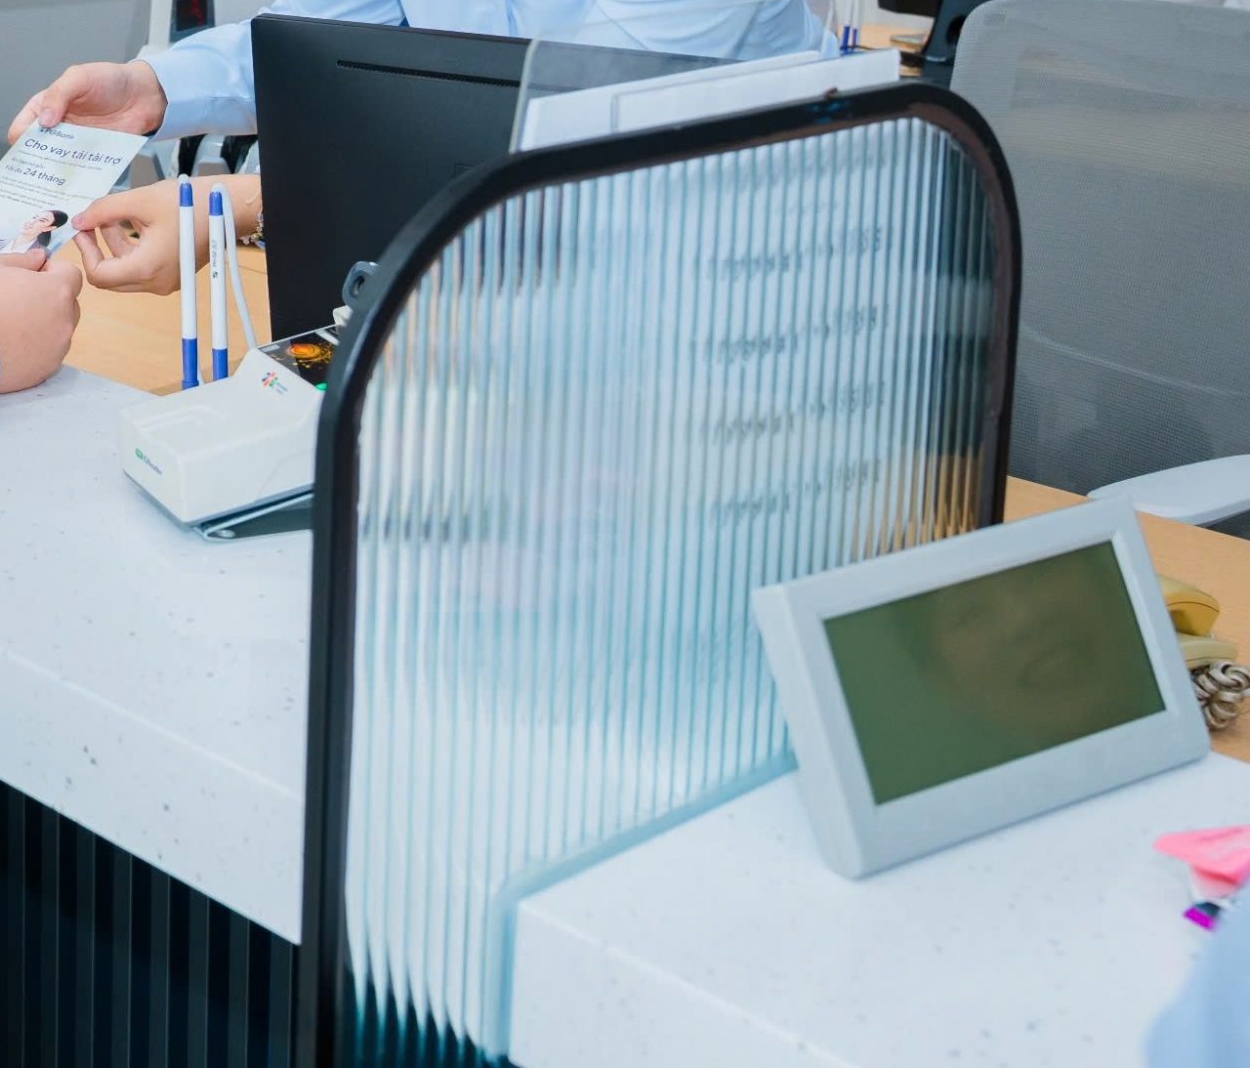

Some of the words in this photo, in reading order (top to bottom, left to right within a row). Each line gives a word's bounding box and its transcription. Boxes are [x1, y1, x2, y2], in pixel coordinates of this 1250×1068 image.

[24, 138, 48, 153] Cho
[50, 146, 71, 158] vay
[104, 156, 124, 167] trợ
[23, 167, 38, 177] 24
[38, 172, 66, 186] tháng
